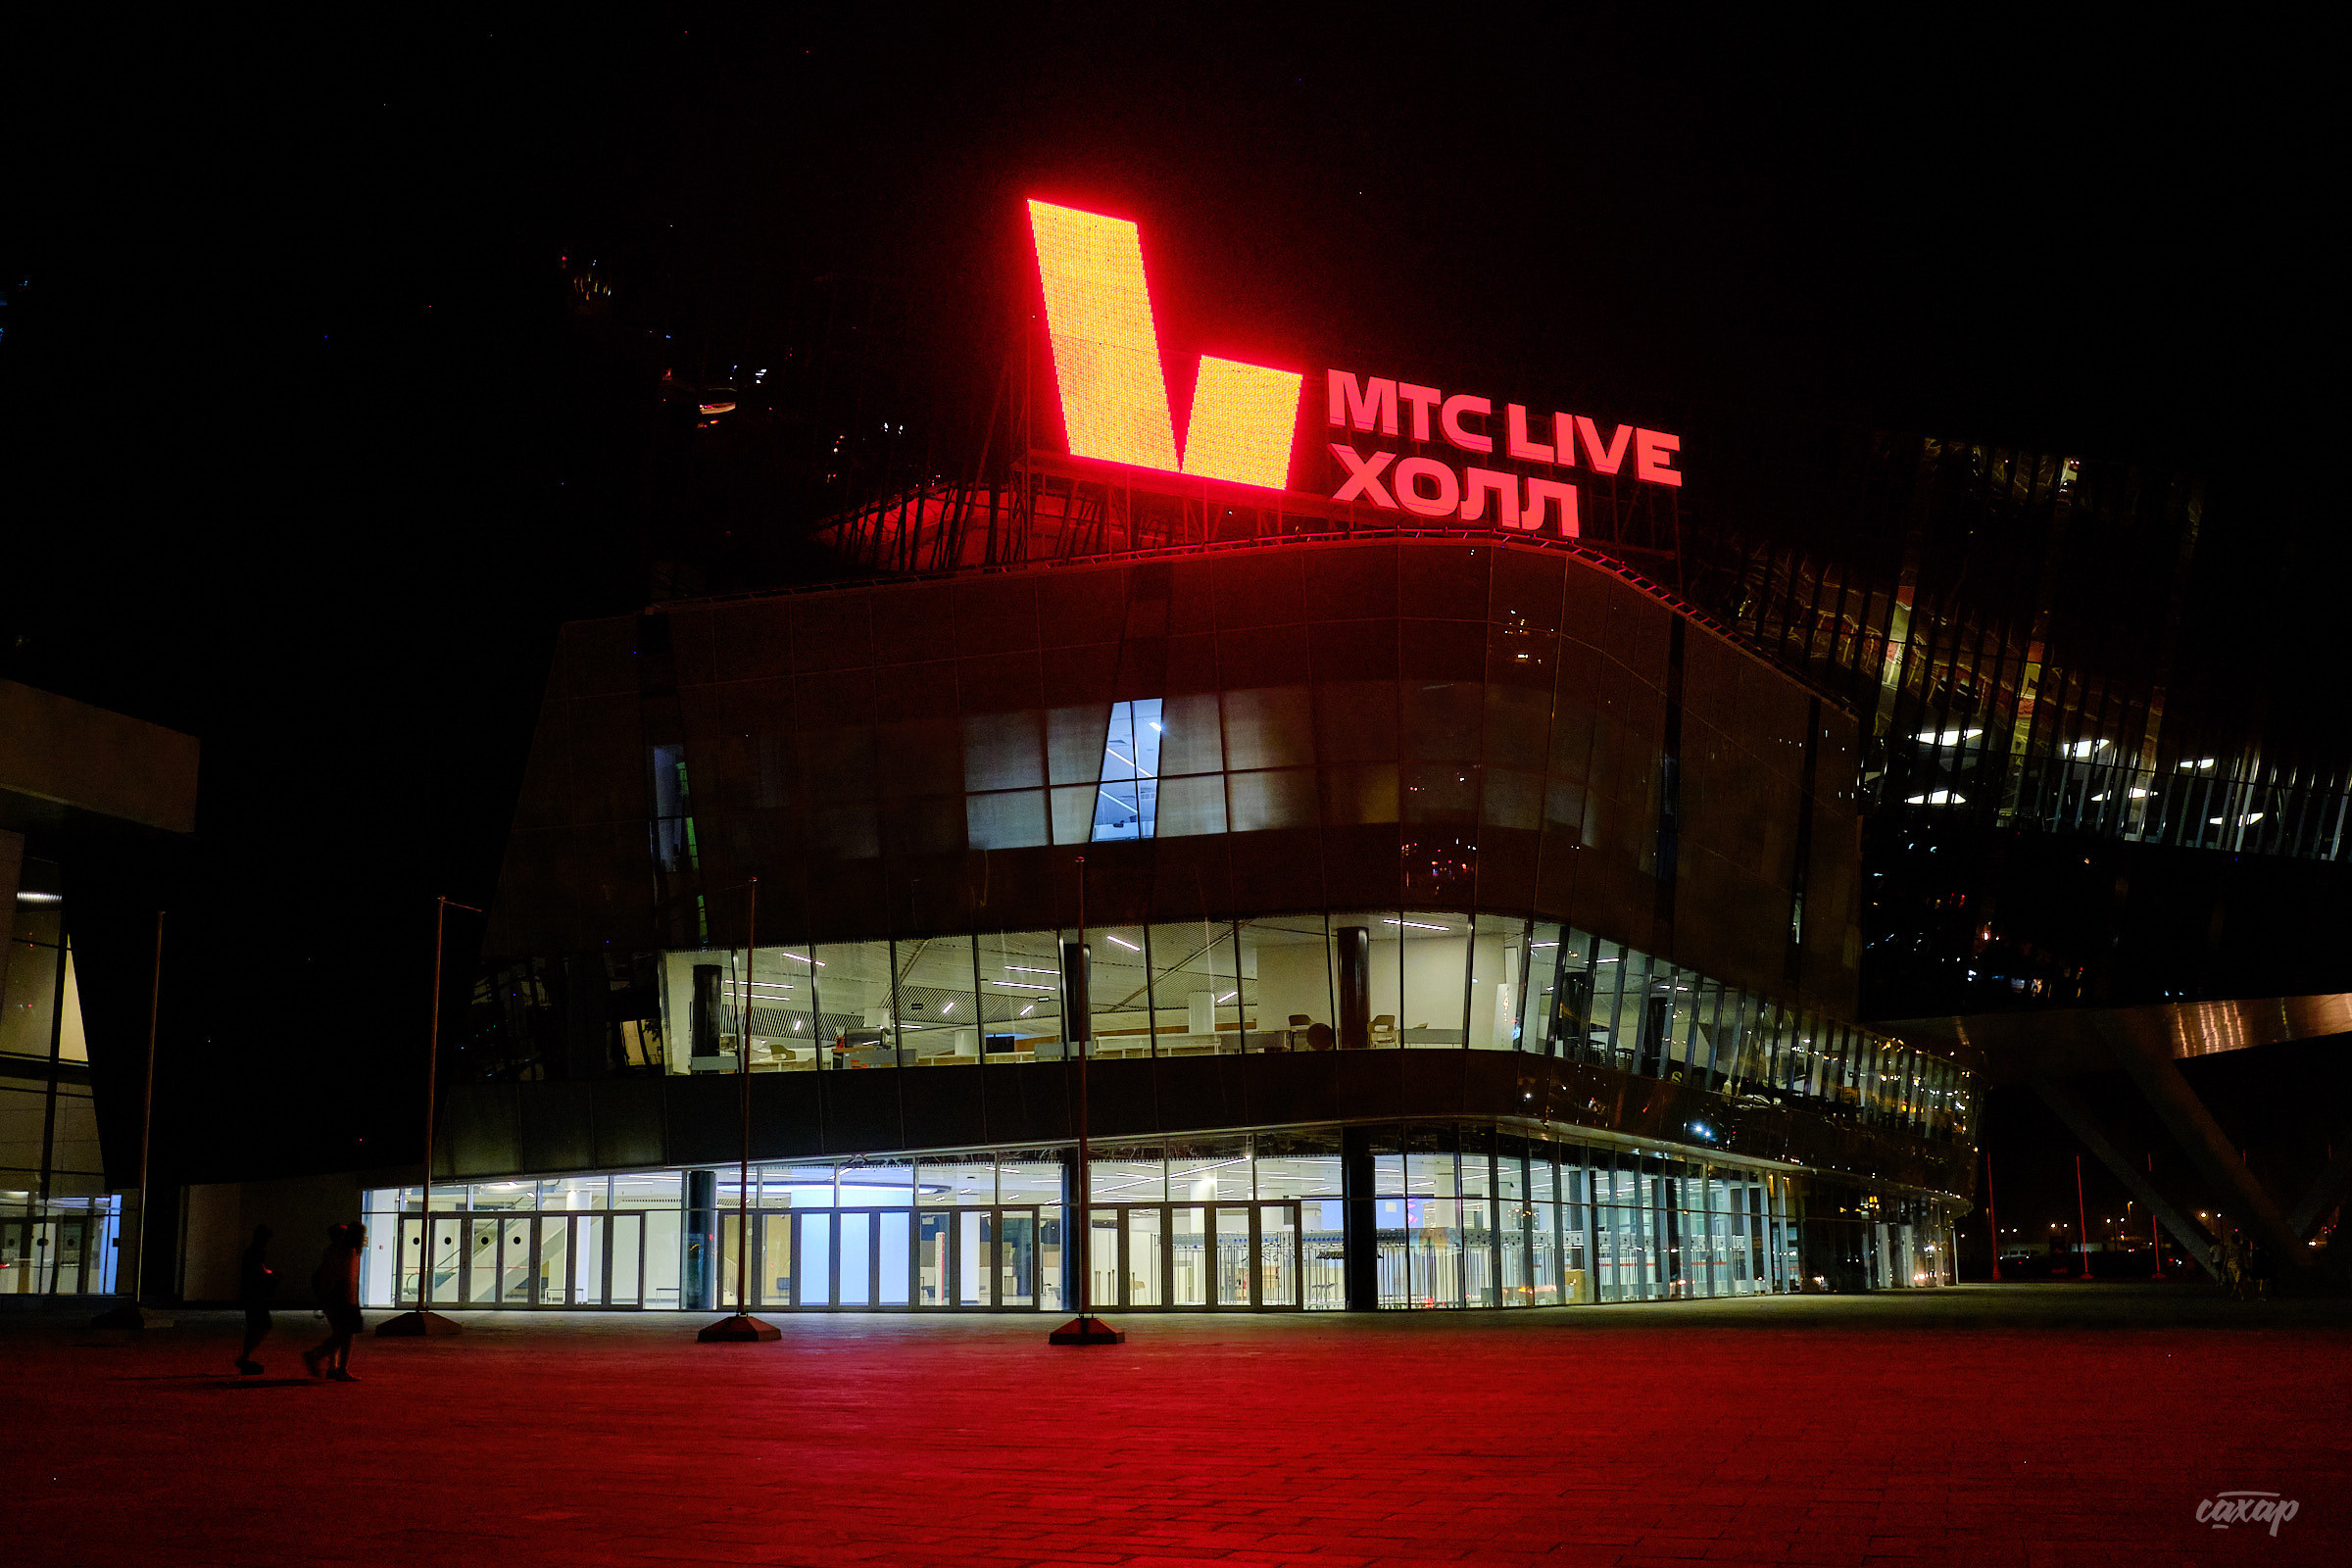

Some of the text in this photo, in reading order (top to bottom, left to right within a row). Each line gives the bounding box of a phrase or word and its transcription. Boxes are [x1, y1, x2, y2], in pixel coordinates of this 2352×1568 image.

[1327, 368, 1683, 488] МТС LIVE
[1329, 442, 1580, 539] ХОЛЛ
